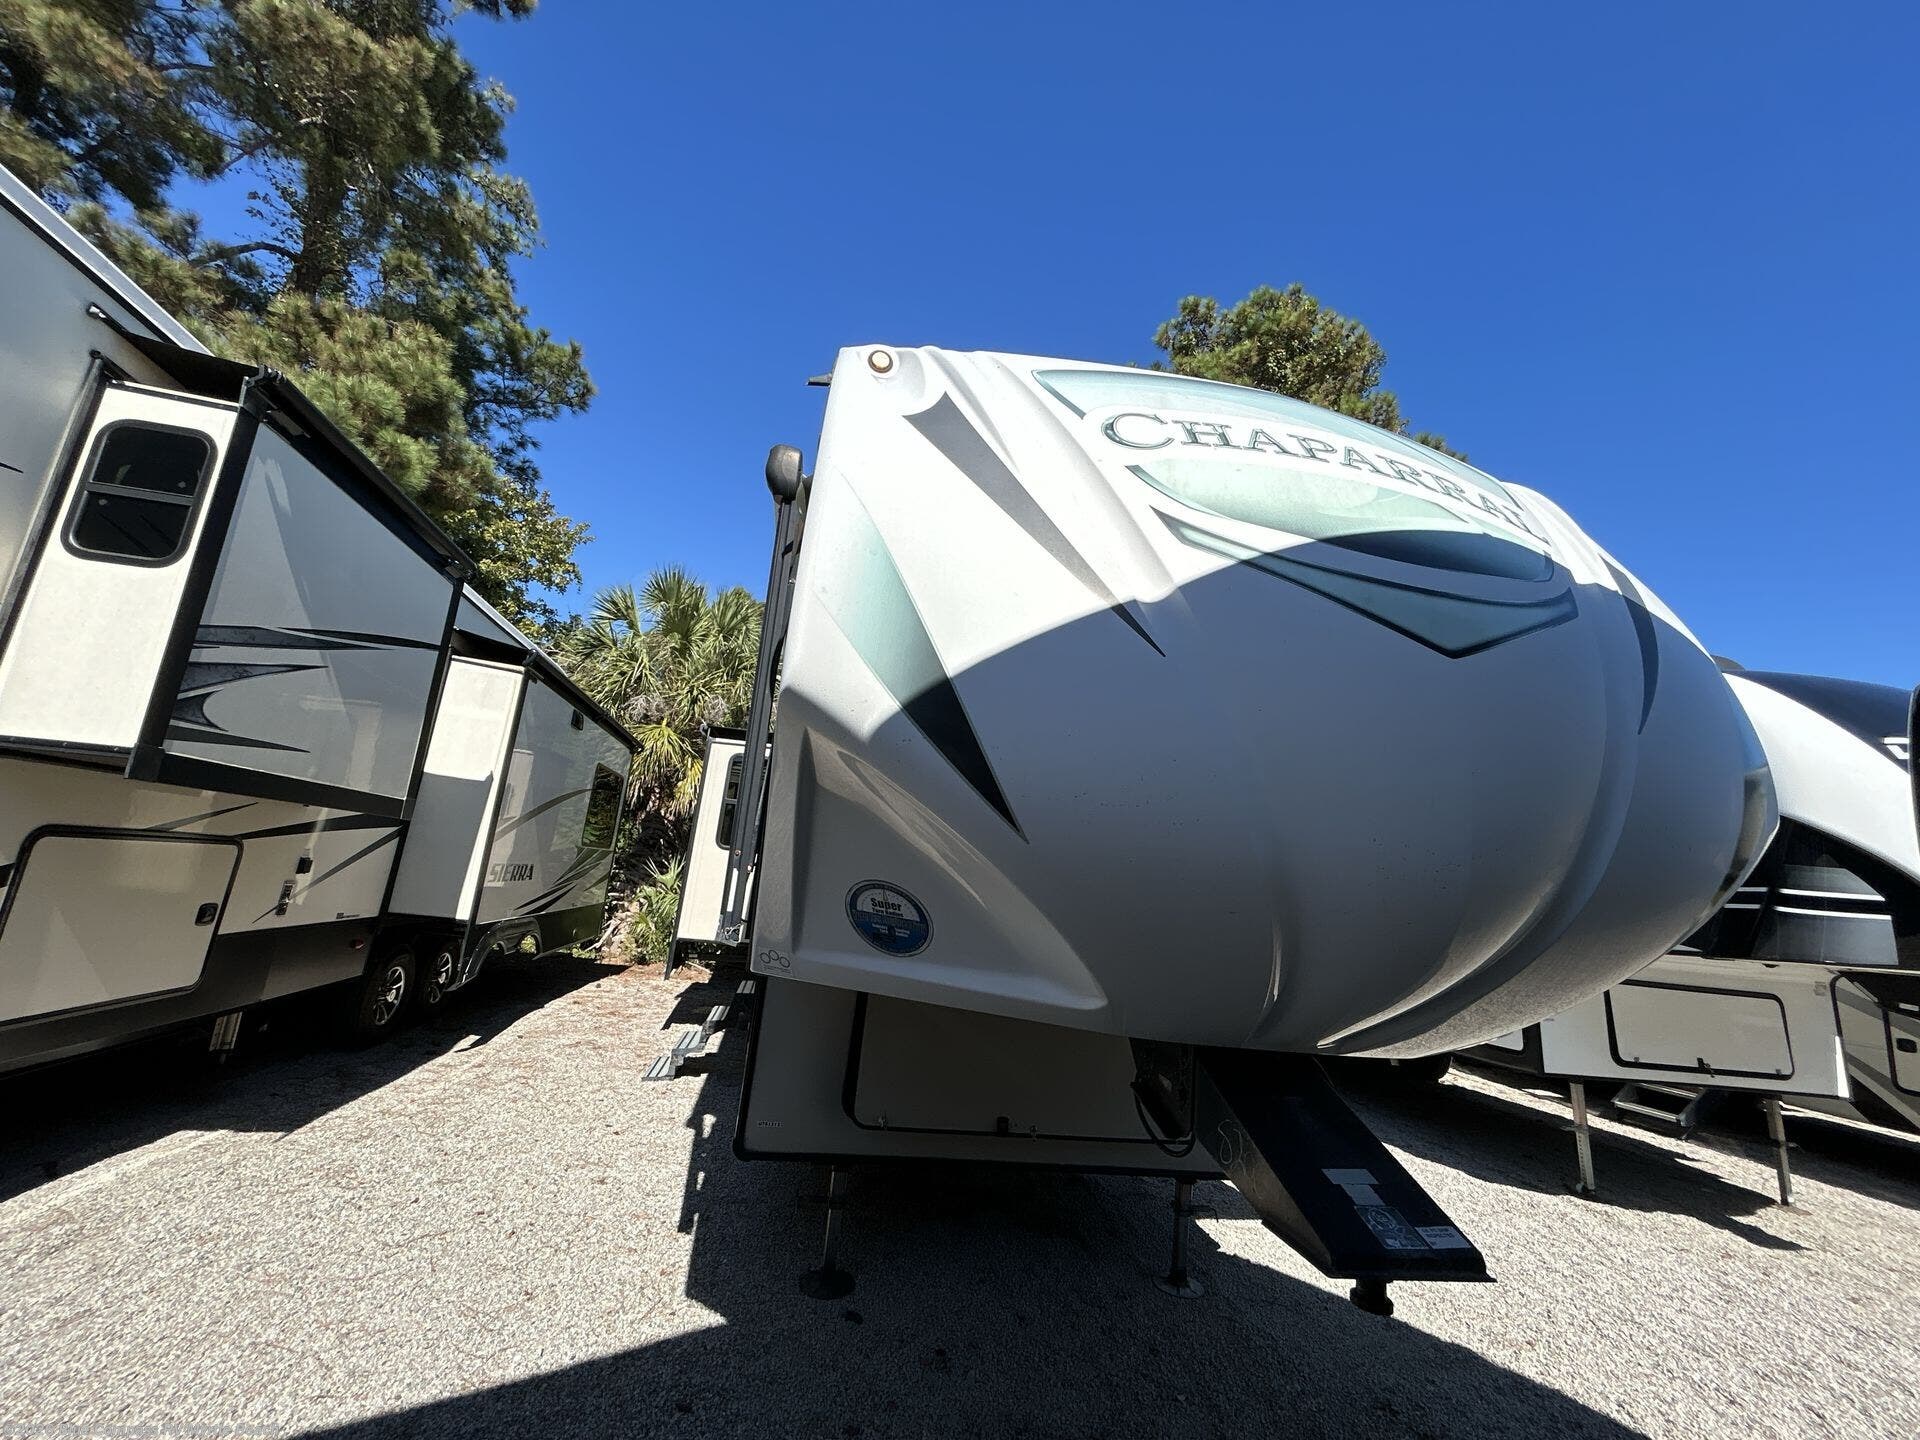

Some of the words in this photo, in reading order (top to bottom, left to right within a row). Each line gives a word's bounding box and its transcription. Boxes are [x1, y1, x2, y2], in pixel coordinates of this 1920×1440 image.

[1101, 411, 1552, 547] CHAPARRAL
[488, 863, 534, 882] SIERRA
[871, 897, 902, 911] Super
